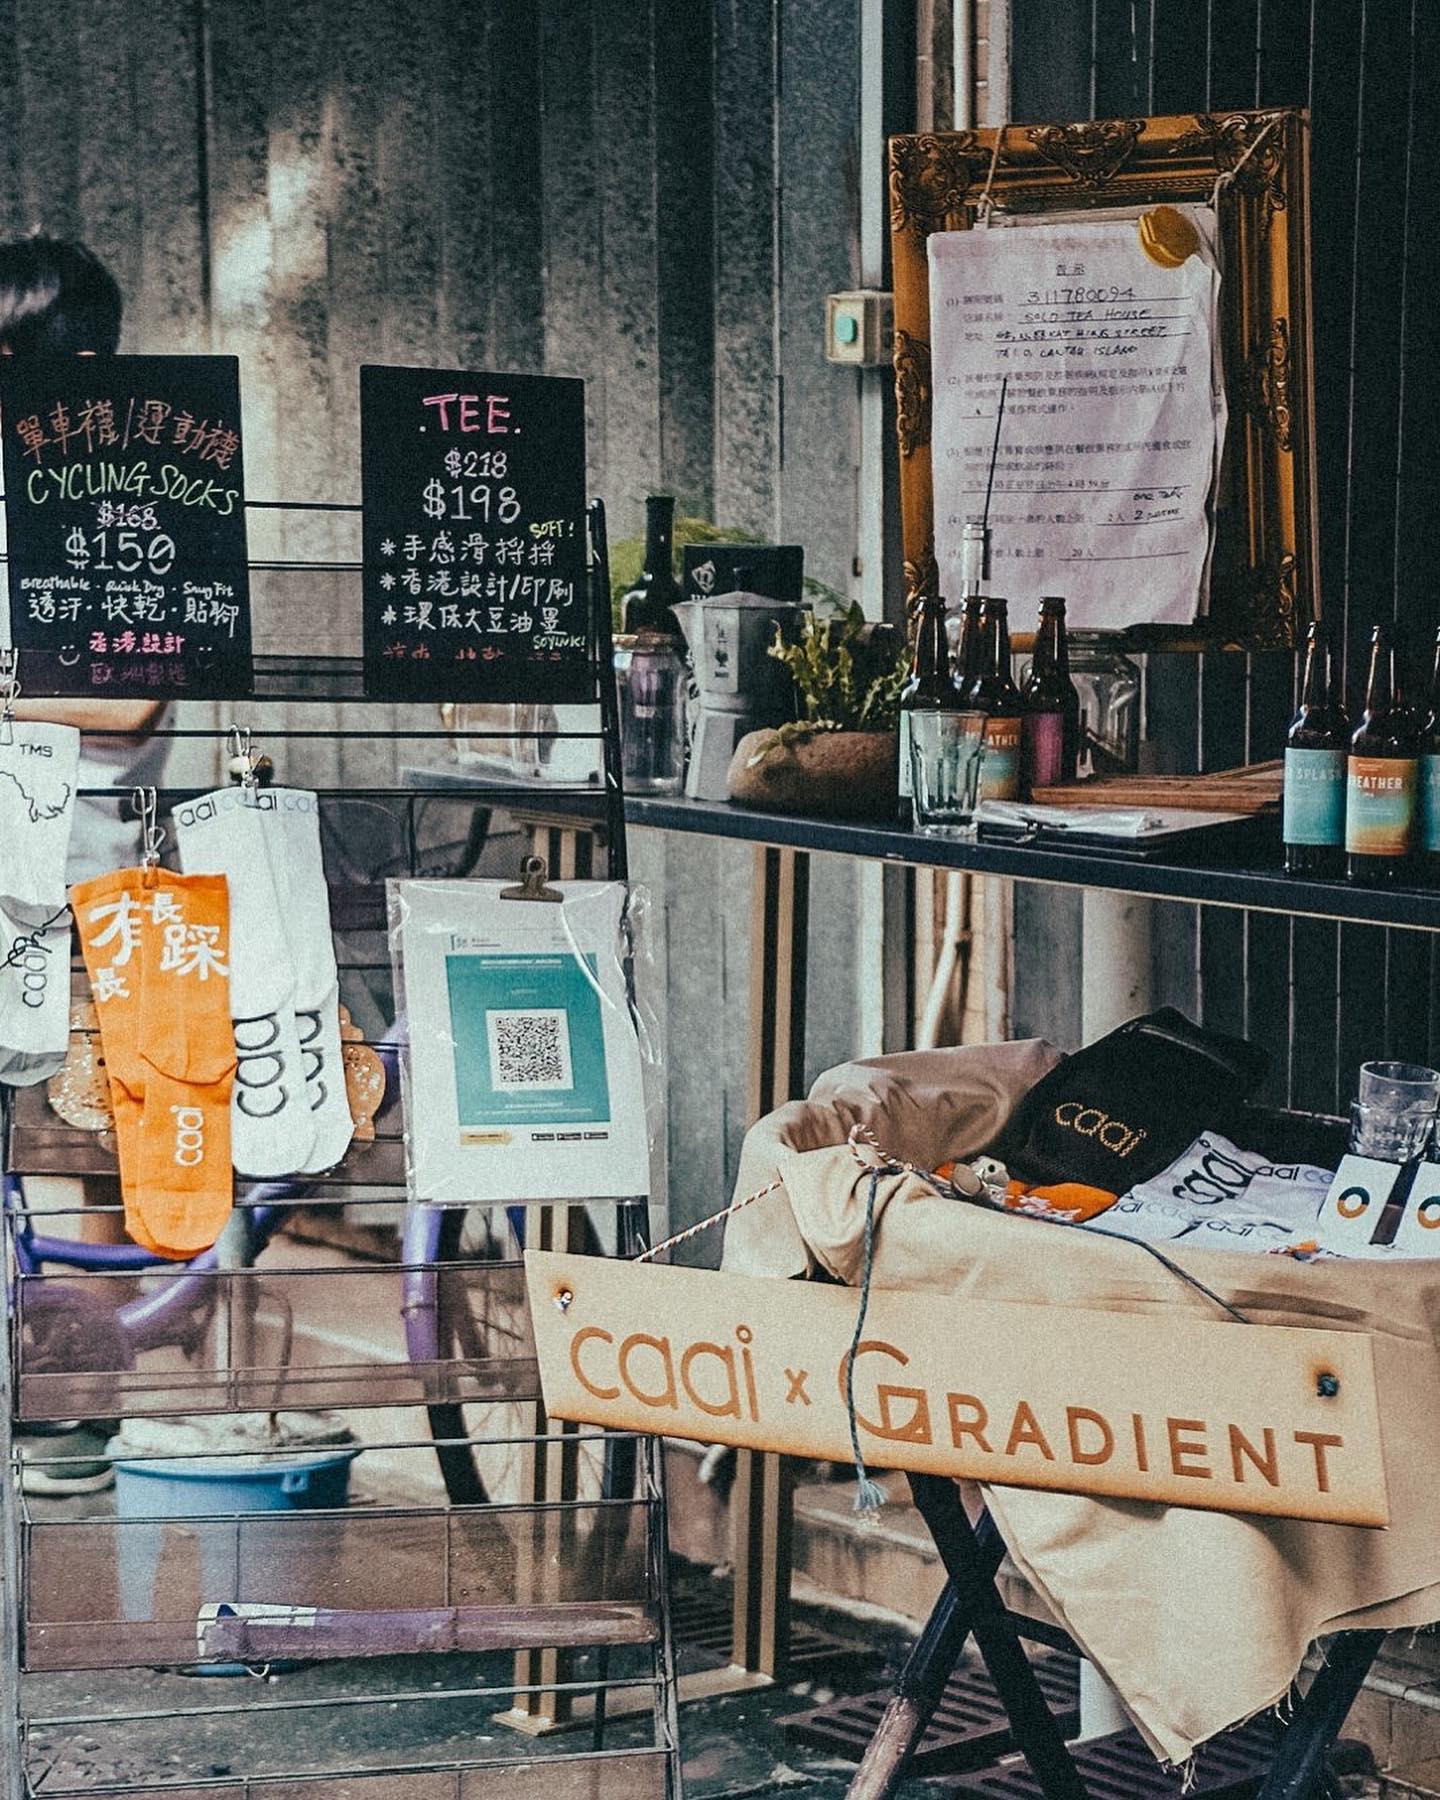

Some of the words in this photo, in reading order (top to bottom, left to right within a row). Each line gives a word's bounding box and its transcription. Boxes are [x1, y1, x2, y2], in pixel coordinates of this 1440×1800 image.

[1027, 286, 1136, 304] 311780094
[444, 447, 508, 478] $218
[28, 461, 151, 504] CYCLING
[150, 464, 239, 515] SOCKS
[423, 478, 521, 524] $198
[66, 527, 175, 574] $150
[143, 581, 165, 598] Dry
[19, 743, 53, 758] TMS
[1350, 775, 1403, 790] EATHER
[1055, 1102, 1147, 1158] caai
[570, 1323, 759, 1423] caai
[784, 1367, 812, 1407] x
[837, 1339, 1343, 1493] GRADIENT
